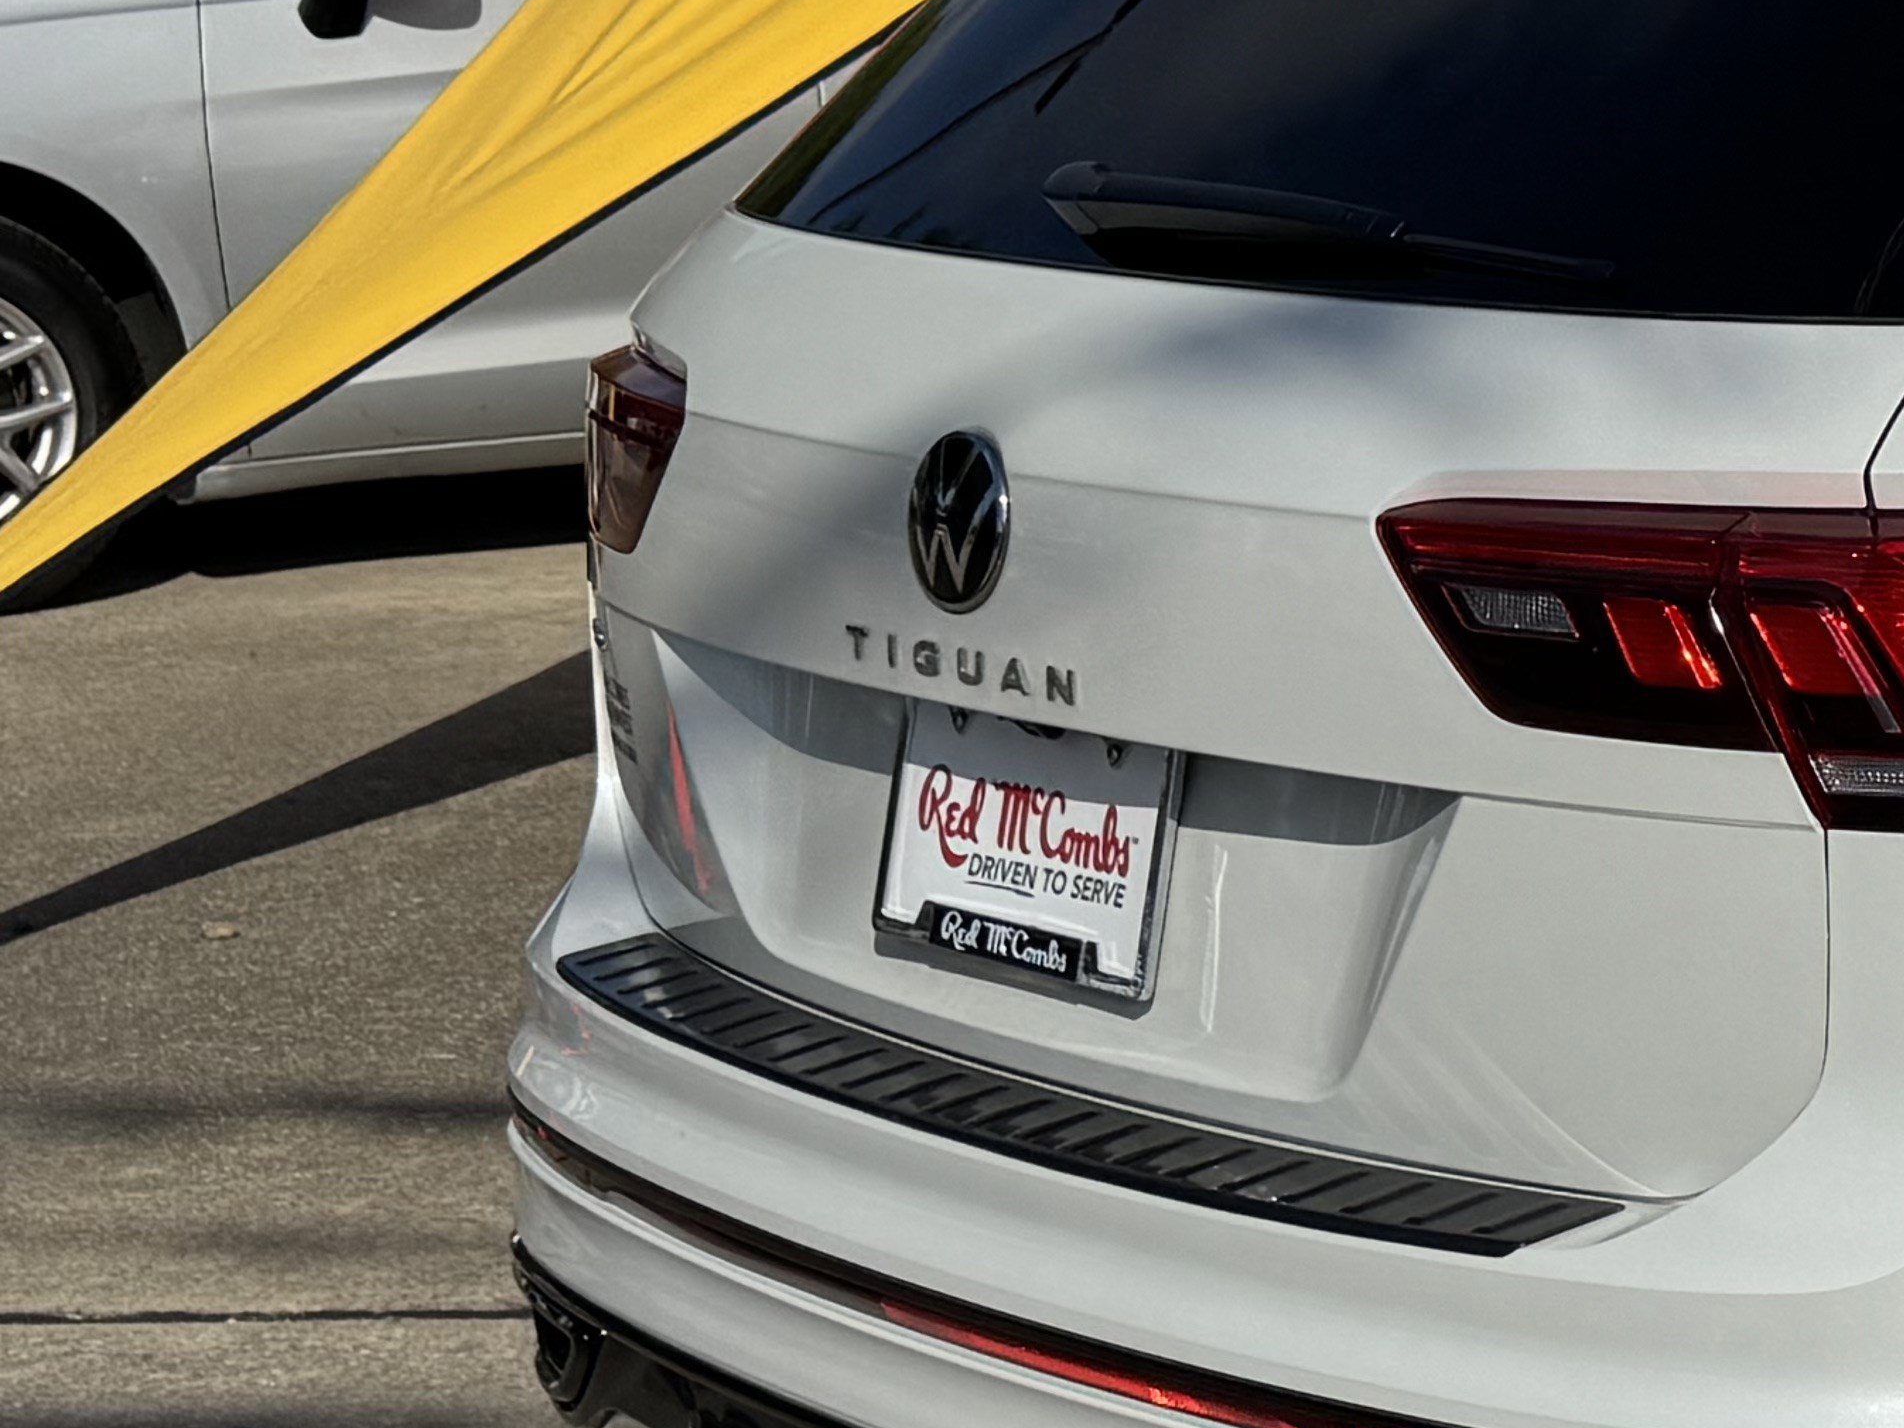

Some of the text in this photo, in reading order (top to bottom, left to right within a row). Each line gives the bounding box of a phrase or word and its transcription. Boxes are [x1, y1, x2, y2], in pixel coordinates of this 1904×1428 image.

[846, 624, 1076, 707] TIGUAN
[918, 763, 987, 868] Red
[967, 853, 1127, 909] DRIVEN TO SERVE
[940, 910, 981, 952] Red
